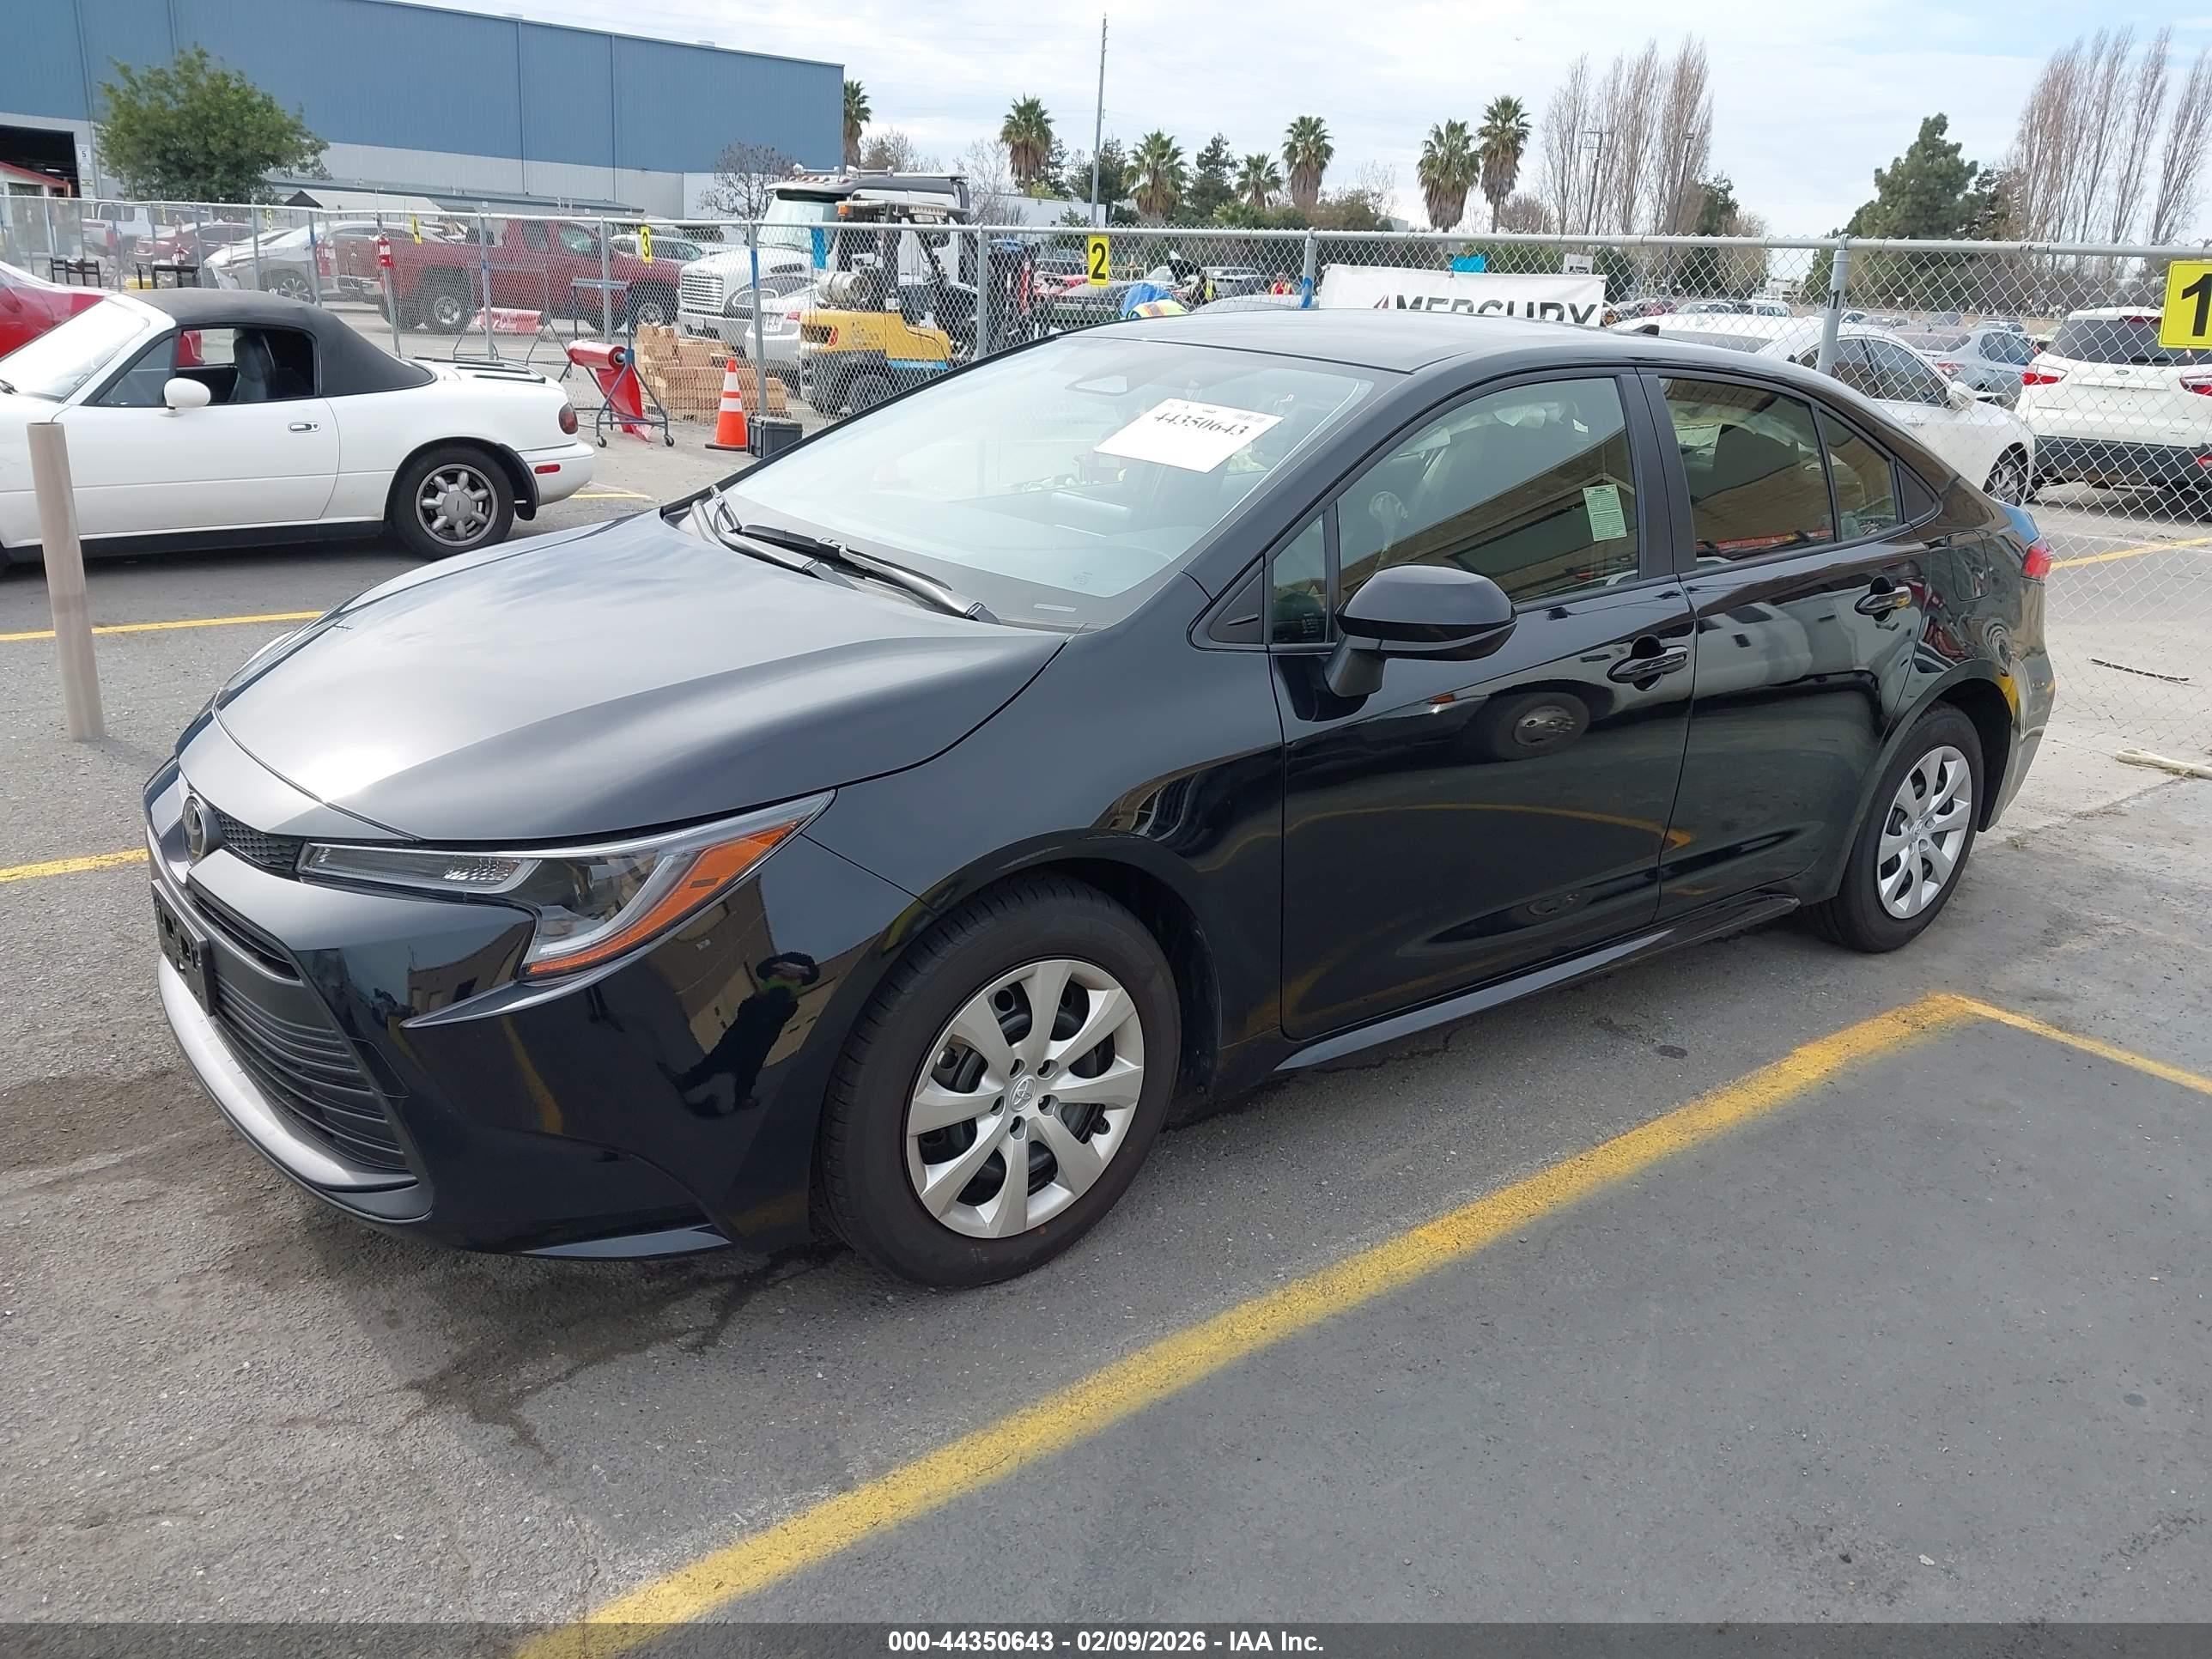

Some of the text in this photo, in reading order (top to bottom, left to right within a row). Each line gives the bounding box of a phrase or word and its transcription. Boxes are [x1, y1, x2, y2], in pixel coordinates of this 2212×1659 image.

[642, 232, 650, 258] 3
[1091, 242, 1106, 280] 2
[2181, 273, 2212, 337] 1
[1154, 412, 1249, 435] 44350643
